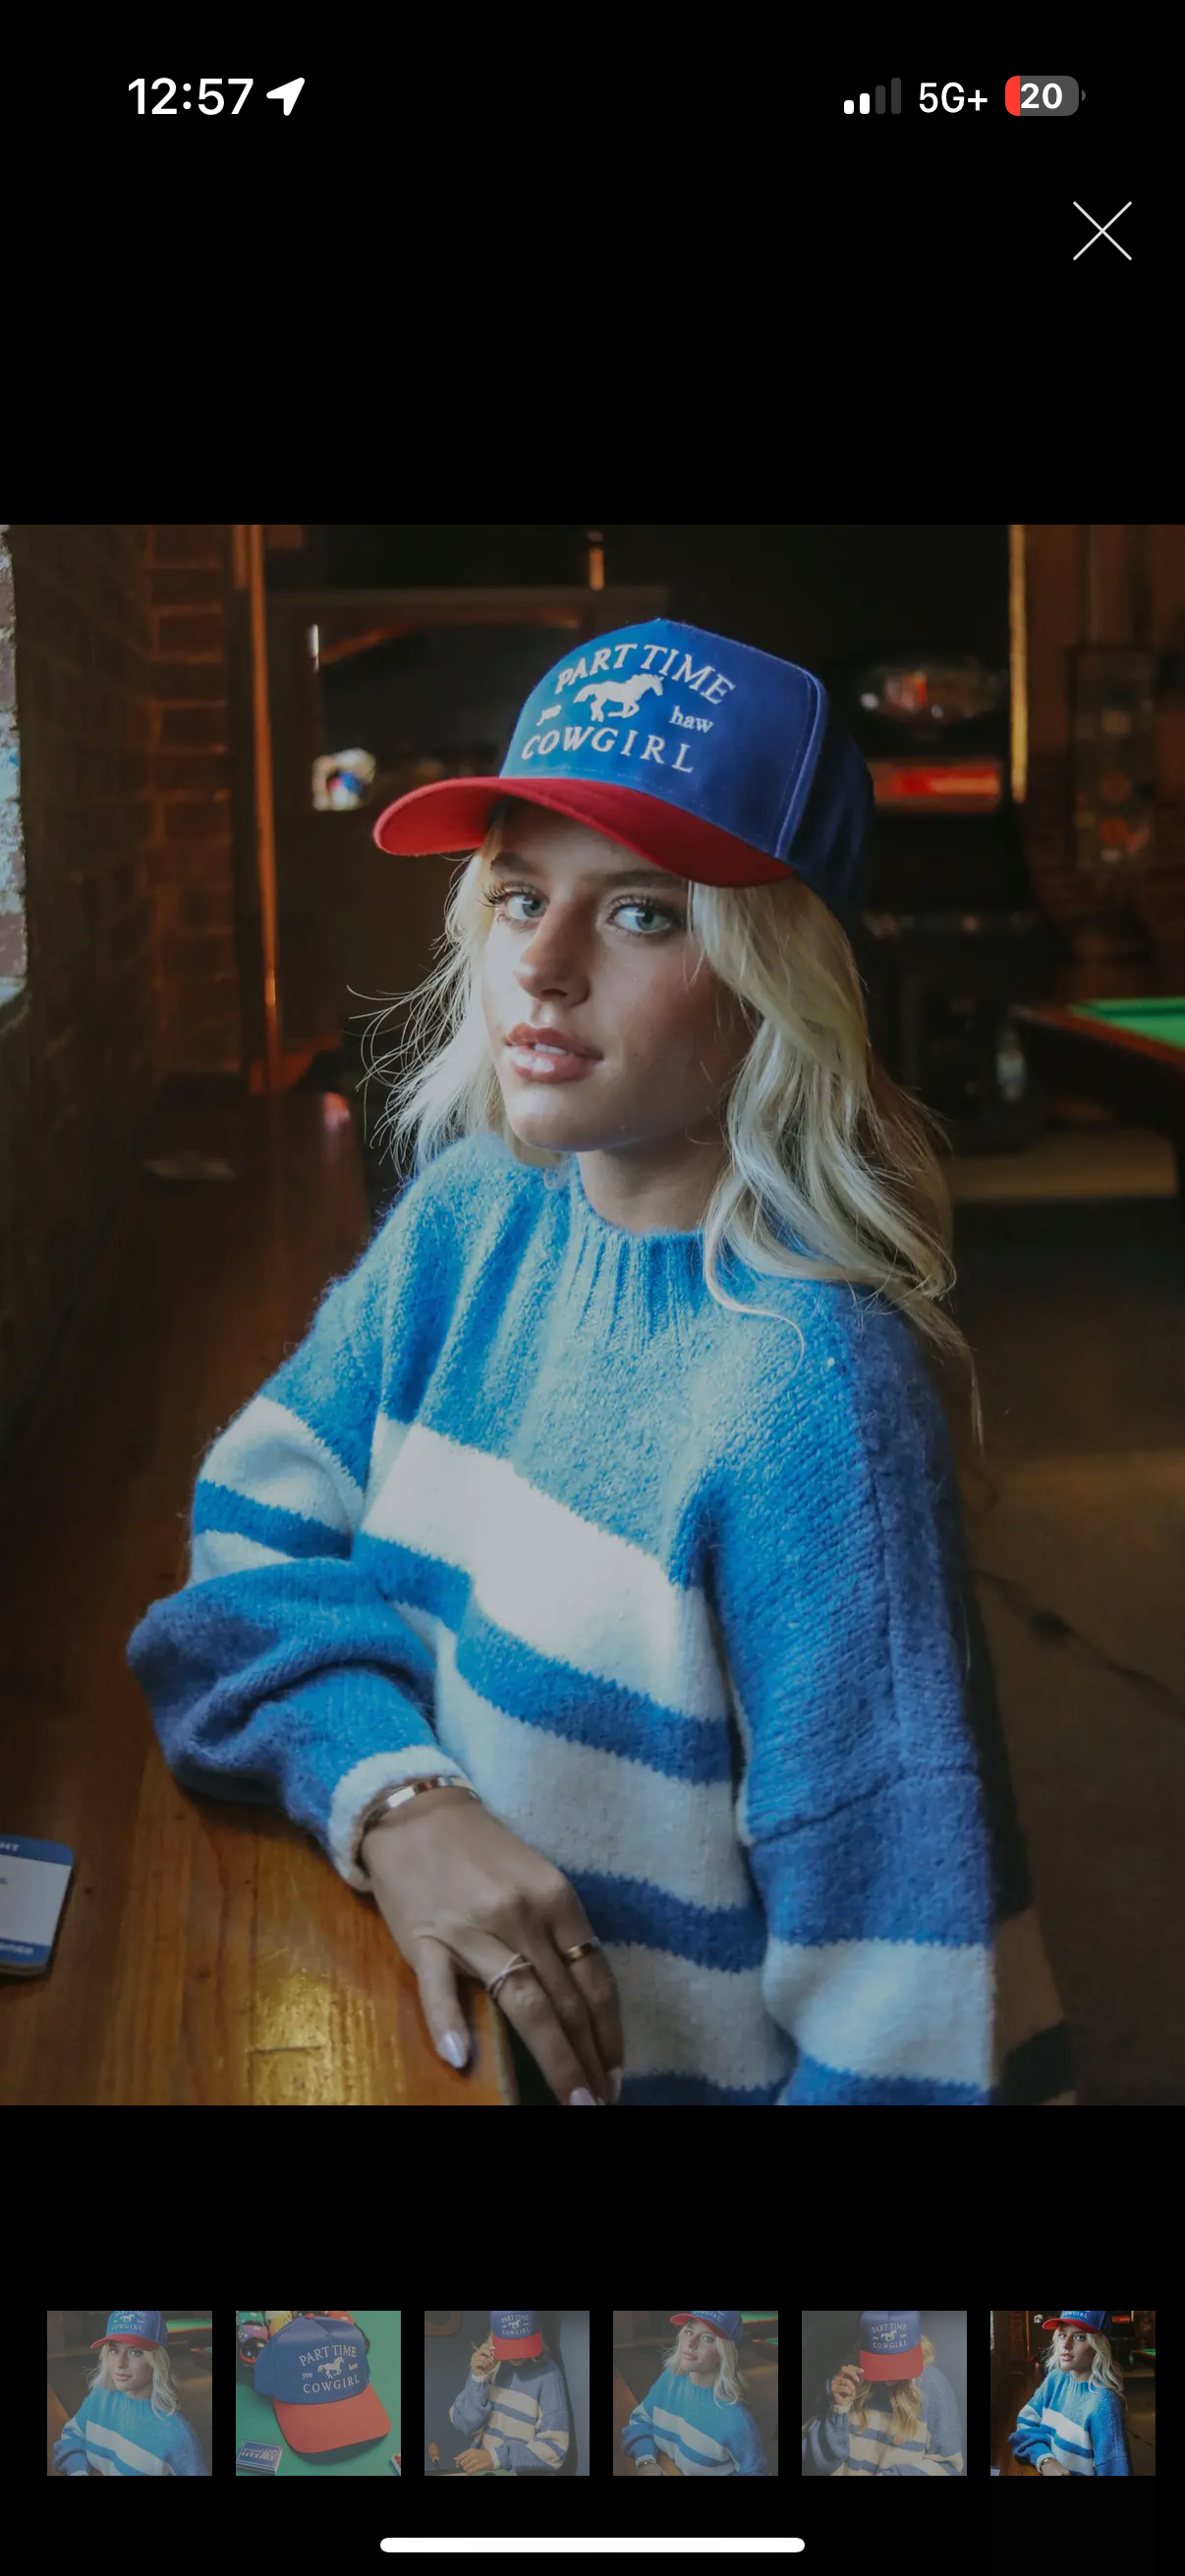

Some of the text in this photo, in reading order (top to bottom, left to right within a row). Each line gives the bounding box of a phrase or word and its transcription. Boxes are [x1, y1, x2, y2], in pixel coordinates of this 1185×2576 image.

[554, 644, 736, 704] PART TIME
[669, 705, 714, 733] haw
[521, 726, 694, 773] COWGIRL
[871, 2323, 907, 2334] PART TIME
[298, 2344, 357, 2367] PART TIME
[873, 2339, 909, 2349] COWGIRL
[303, 2374, 361, 2393] COWGIRL
